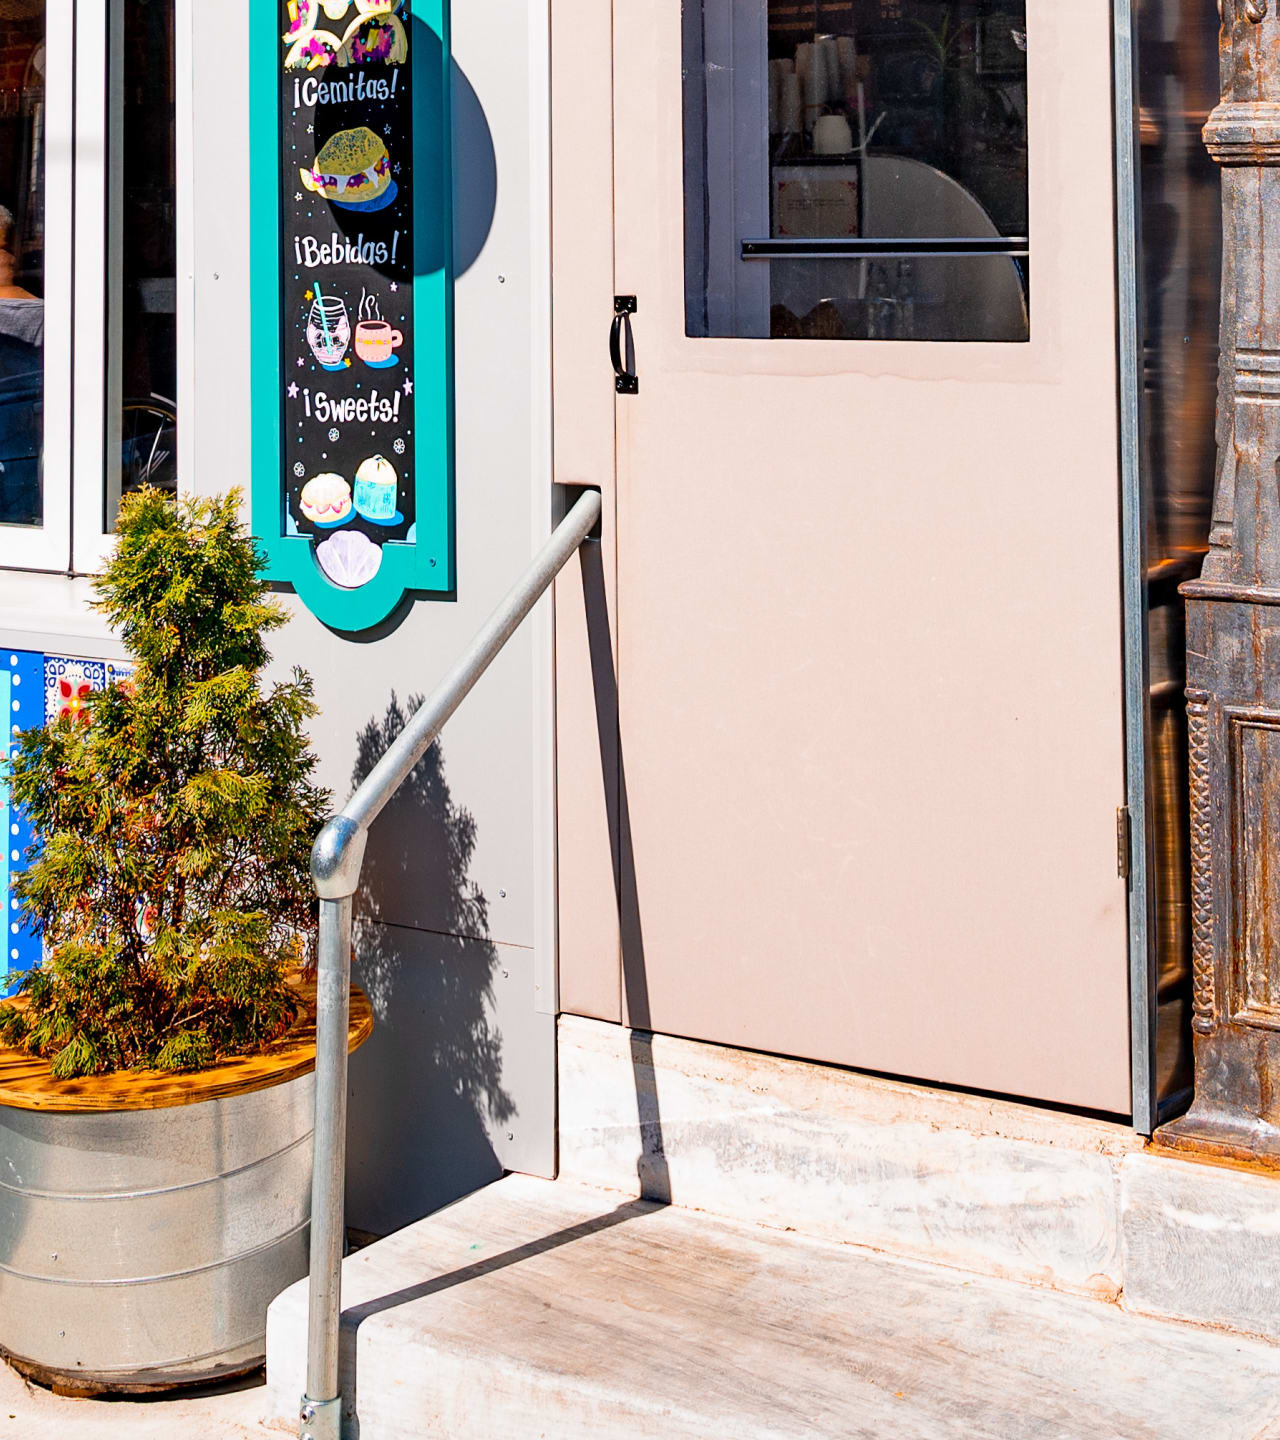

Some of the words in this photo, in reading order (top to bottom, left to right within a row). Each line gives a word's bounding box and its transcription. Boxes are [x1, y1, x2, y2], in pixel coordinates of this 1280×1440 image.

[293, 68, 400, 109] ¡Cemitas!
[293, 230, 400, 268] ¡Bebidas!
[302, 388, 402, 424] ¡Sweets!
